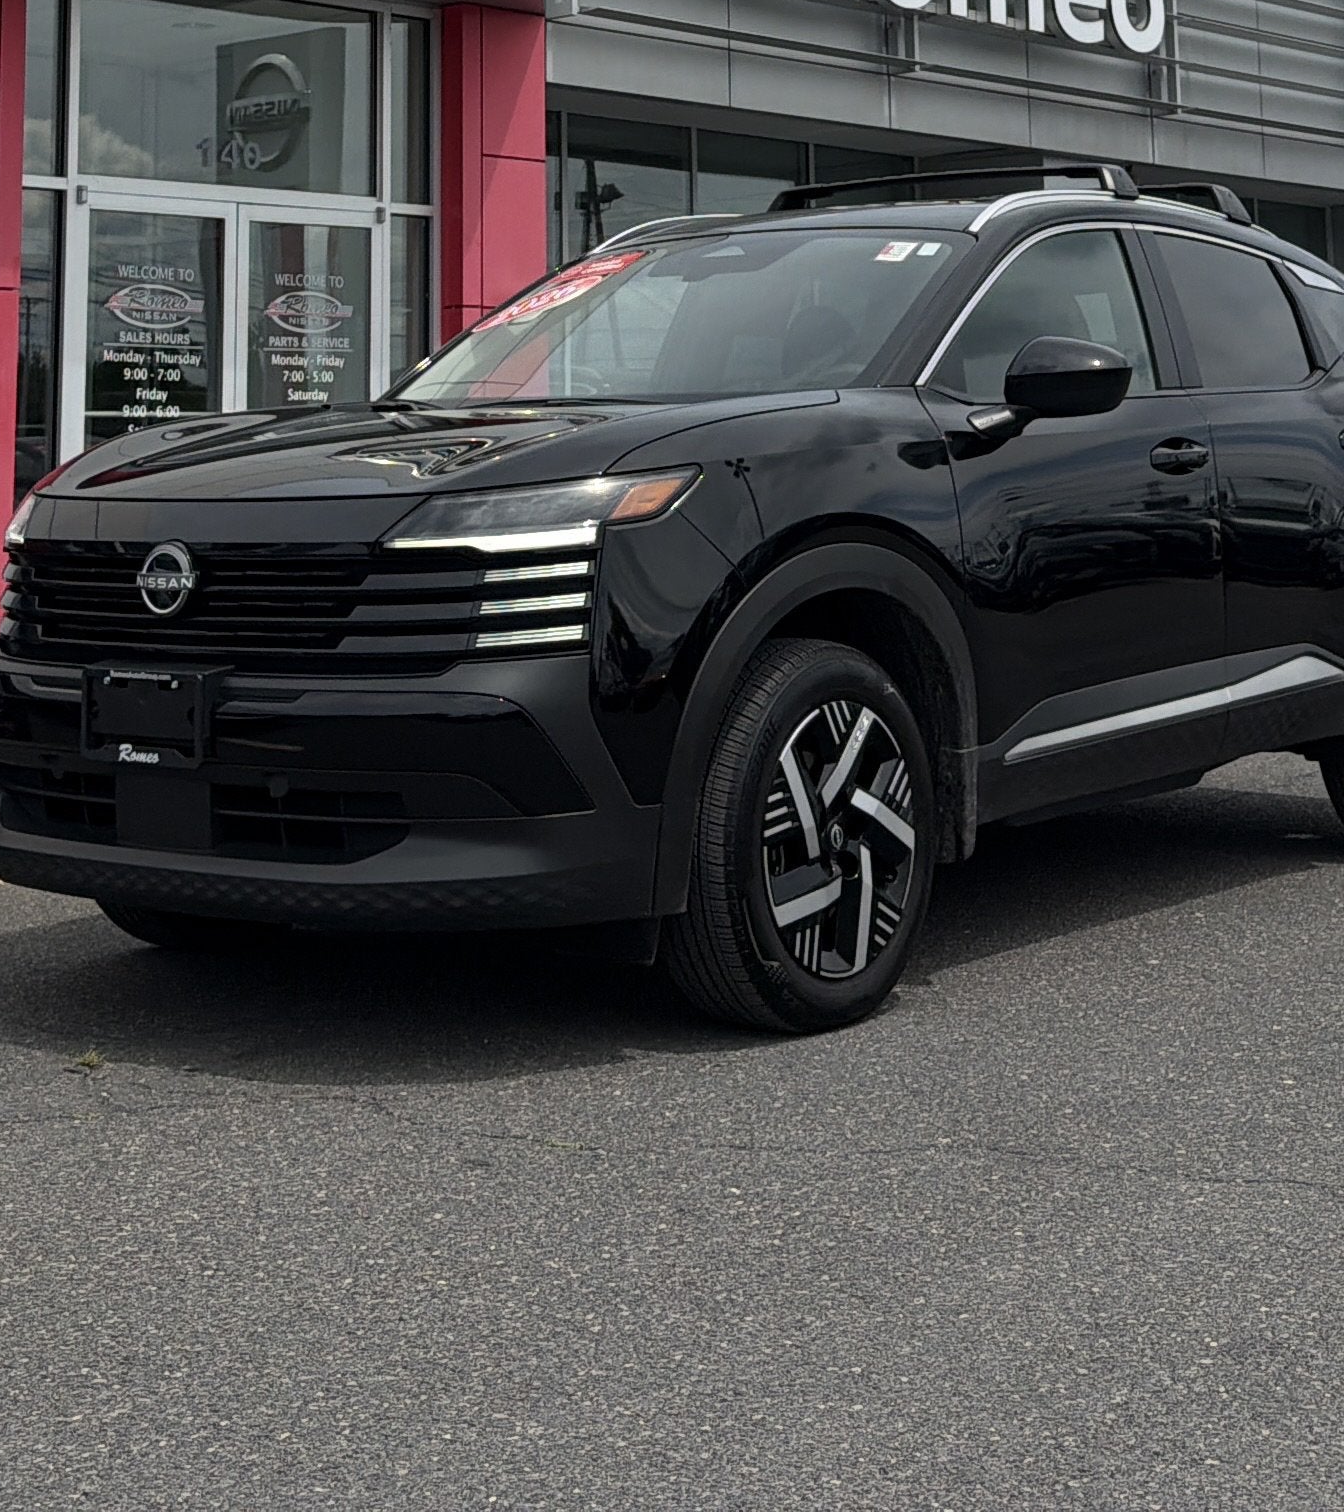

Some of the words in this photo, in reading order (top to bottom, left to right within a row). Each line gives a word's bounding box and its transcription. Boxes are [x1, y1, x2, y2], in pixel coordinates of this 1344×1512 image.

[117, 264, 175, 282] WELCOME
[177, 268, 195, 282] TO
[274, 273, 327, 287] WELCOME
[329, 275, 344, 288] TO
[127, 287, 189, 309] Romeo
[131, 310, 177, 321] NISSAN
[119, 331, 152, 343] SALES
[154, 332, 191, 345] HOURS
[268, 335, 299, 348] PARTS
[301, 337, 308, 348] &
[311, 336, 350, 348] SERVICE
[103, 349, 145, 365] Monday
[154, 351, 202, 367] Thursday
[271, 354, 310, 368] Monday
[316, 354, 346, 368] Friday
[123, 368, 148, 381] 9:00
[157, 369, 181, 382] 7:00
[282, 370, 305, 383] 7:00
[312, 370, 334, 383] 5:00
[135, 387, 169, 403] Friday
[287, 388, 329, 403] Saturday
[122, 405, 147, 418] 9:00
[156, 405, 181, 418] 6:00
[136, 574, 193, 589] NISSAN
[118, 743, 160, 764] Romeo
